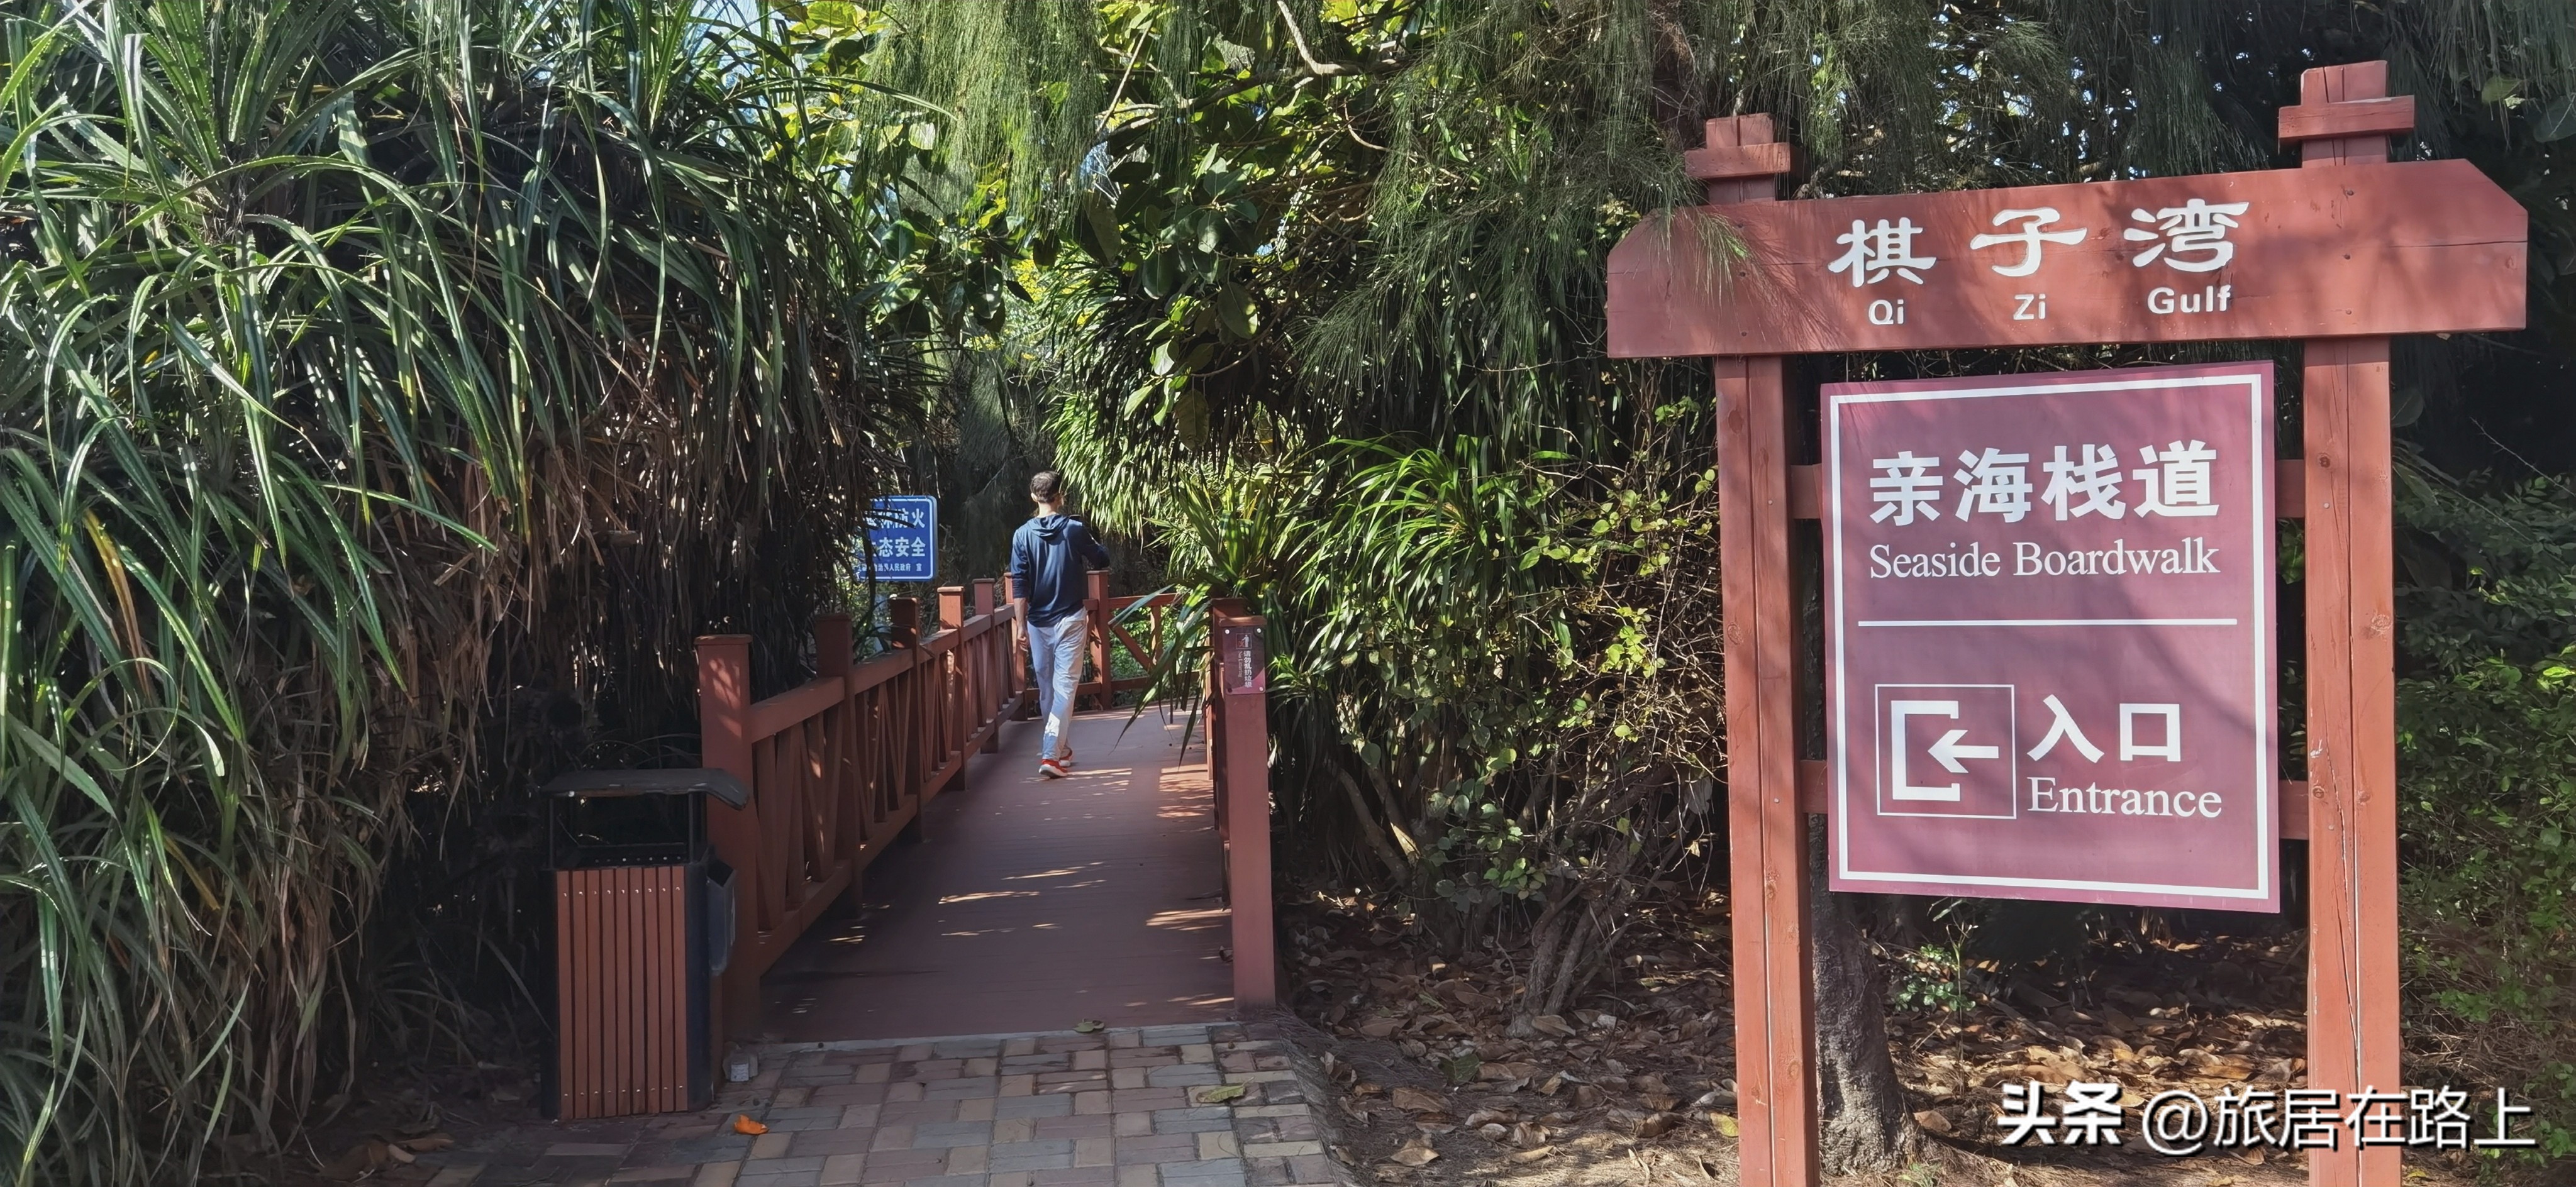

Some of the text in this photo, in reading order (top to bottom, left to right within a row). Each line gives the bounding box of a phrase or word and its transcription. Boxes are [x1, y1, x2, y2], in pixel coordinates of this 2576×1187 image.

[1827, 197, 2250, 288] 棋子湾
[1868, 285, 2231, 325] Qi Zi Gulf
[1869, 439, 2219, 526] 亲海栈道
[872, 537, 926, 557] 态安全
[1870, 536, 2221, 578] Seaside Boardwalk
[2026, 694, 2181, 763] 入口
[2027, 776, 2222, 818] Entrance
